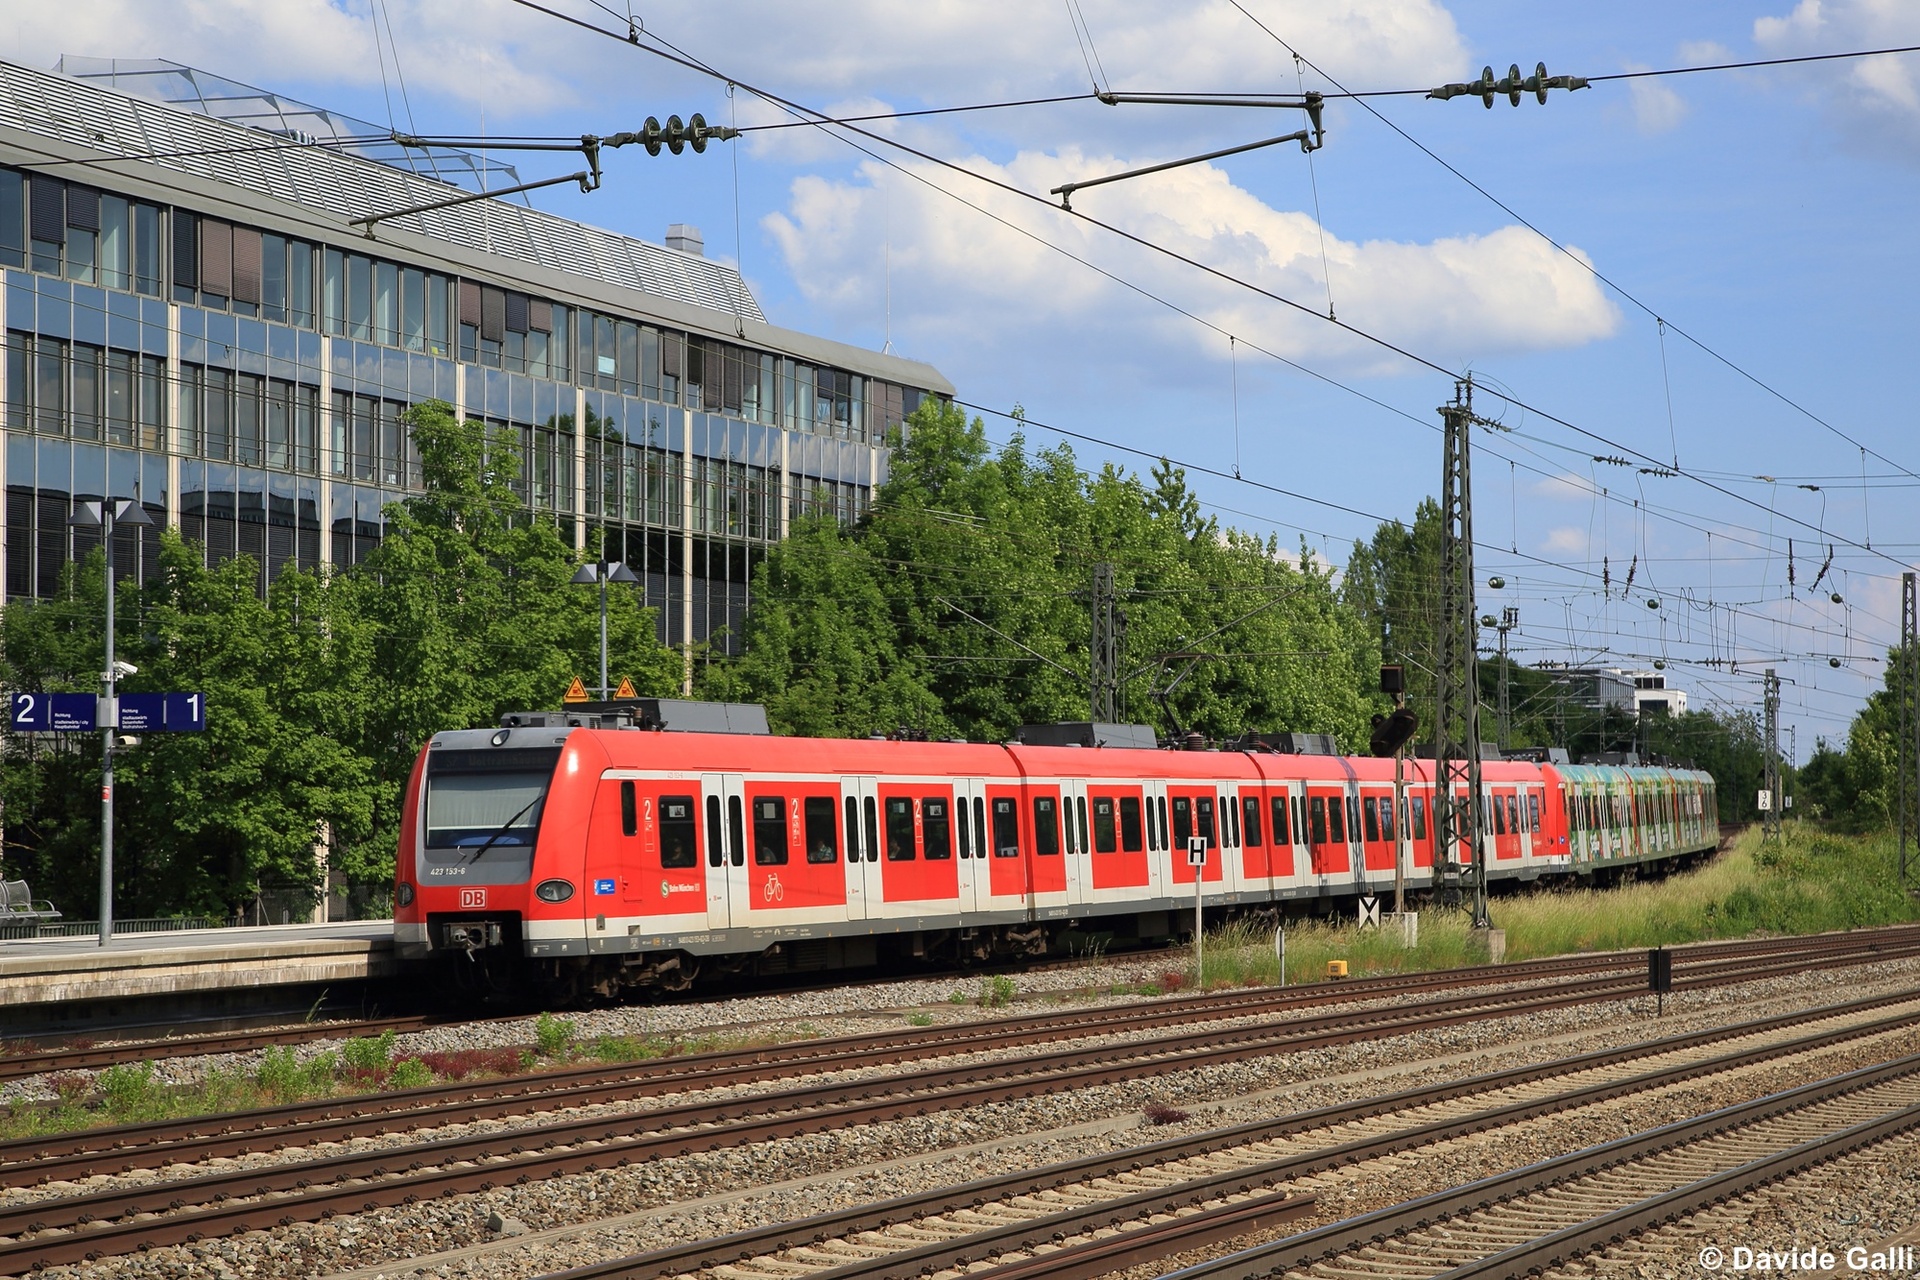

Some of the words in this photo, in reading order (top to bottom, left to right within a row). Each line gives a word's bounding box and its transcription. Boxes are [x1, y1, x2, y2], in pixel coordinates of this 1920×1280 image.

[16, 694, 35, 723] 2
[186, 694, 198, 722] 1
[1762, 791, 1767, 799] 3
[1762, 800, 1767, 808] 6
[644, 799, 651, 820] 2
[792, 799, 799, 818] 2
[1190, 839, 1205, 863] H
[430, 868, 444, 876] 423
[445, 867, 466, 875] 153-6
[463, 891, 484, 906] DB
